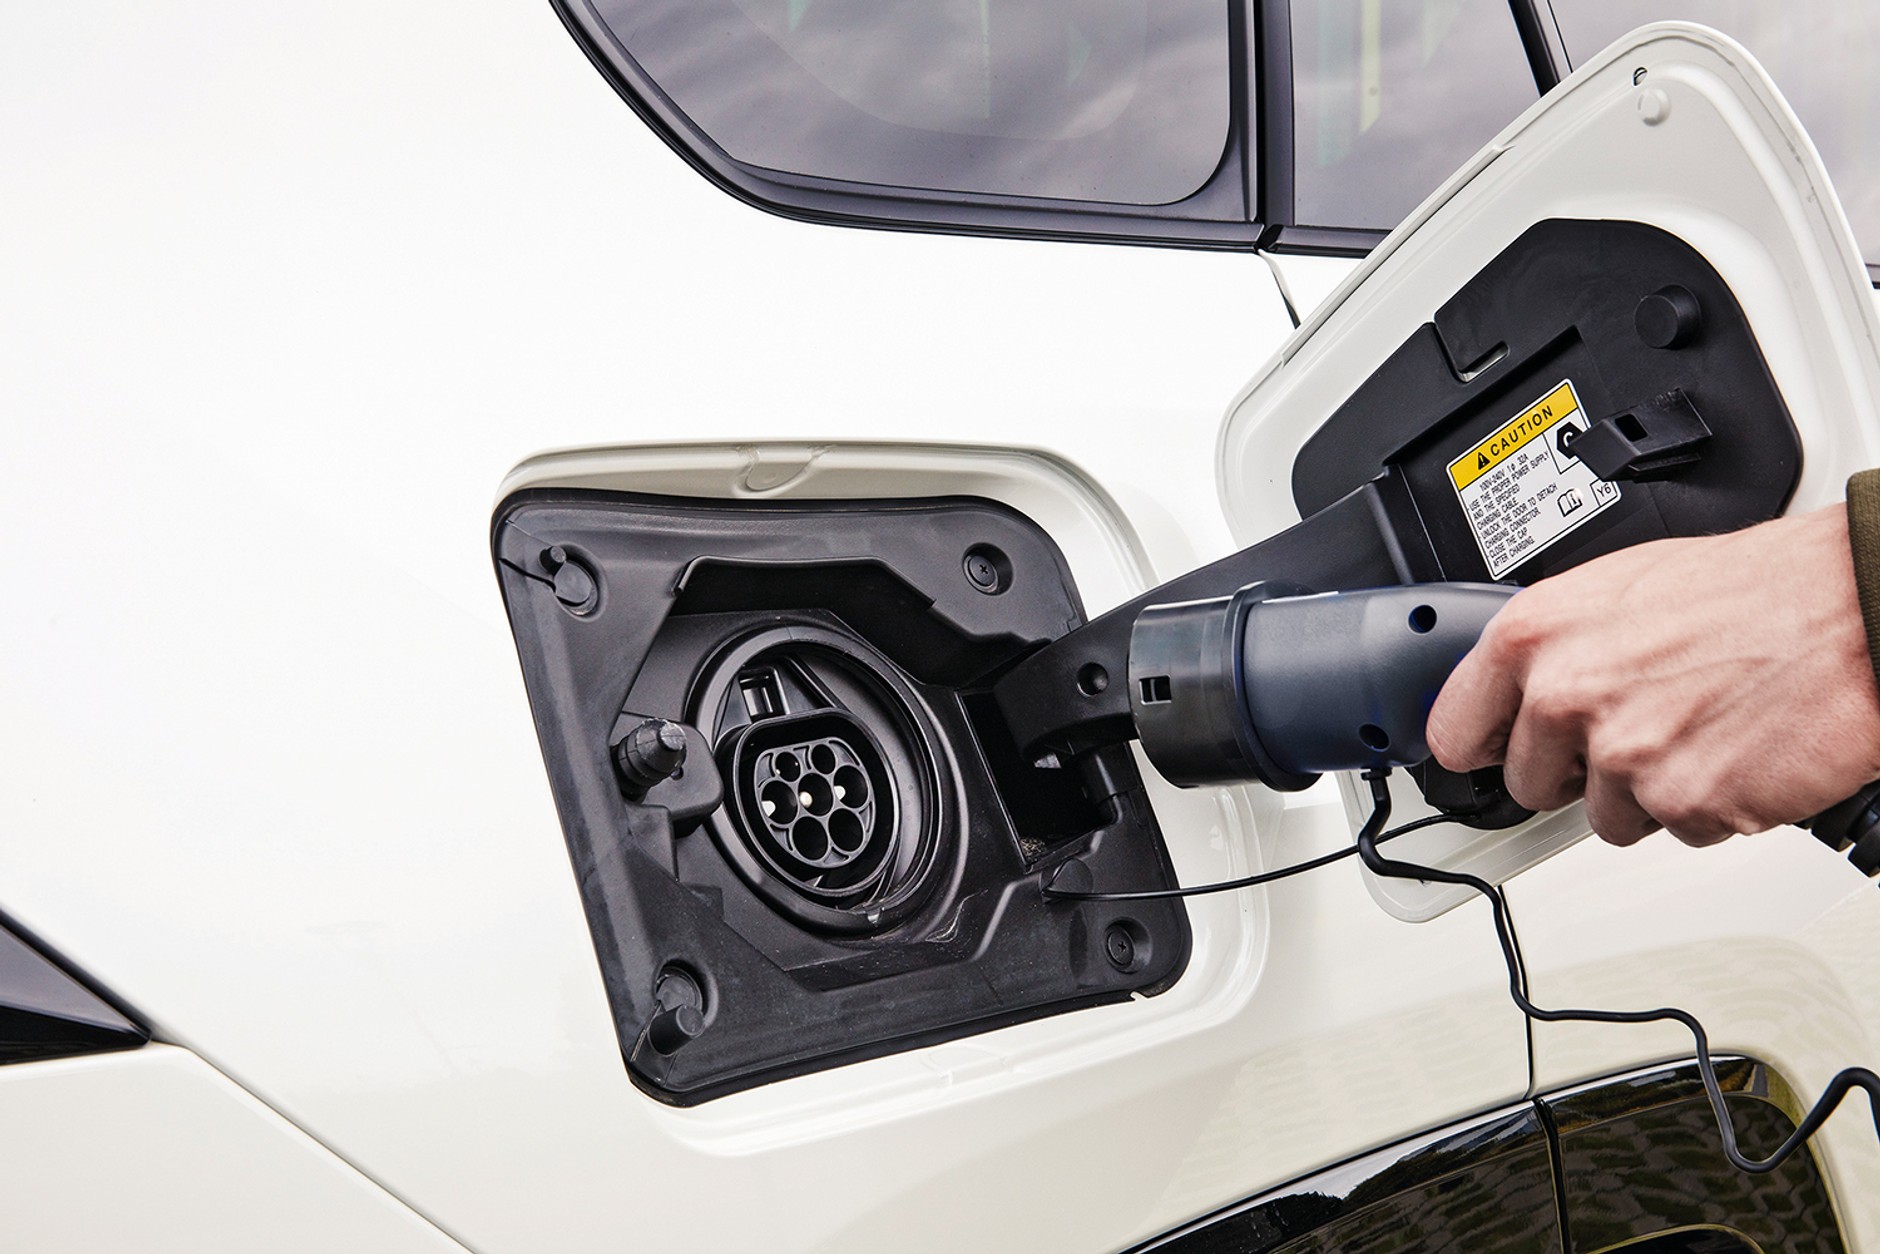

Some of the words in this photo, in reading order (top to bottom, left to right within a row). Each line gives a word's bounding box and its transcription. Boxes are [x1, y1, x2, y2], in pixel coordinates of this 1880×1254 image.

[1490, 405, 1553, 456] CAUTION
[1469, 498, 1481, 511] USE
[1479, 490, 1491, 503] THE
[1490, 476, 1511, 495] PROPER
[1510, 463, 1530, 482] POWER
[1529, 450, 1549, 469] SUPPLY
[1596, 480, 1612, 497] Y6
[1472, 508, 1484, 521] AND
[1483, 500, 1495, 512] THE
[1495, 482, 1520, 506] SPECIFIED
[1480, 521, 1501, 540] UNLOCK
[1500, 512, 1512, 525] THE
[1511, 502, 1528, 518] DOOR
[1527, 496, 1536, 507] TO
[1536, 482, 1558, 502] DETACH
[1476, 508, 1501, 530] CHARGING
[1484, 527, 1510, 549] CHARGING
[1489, 541, 1506, 559] CLOSE
[1505, 534, 1517, 546] THE
[1516, 526, 1527, 540] CAP
[1492, 552, 1509, 567] AFTER
